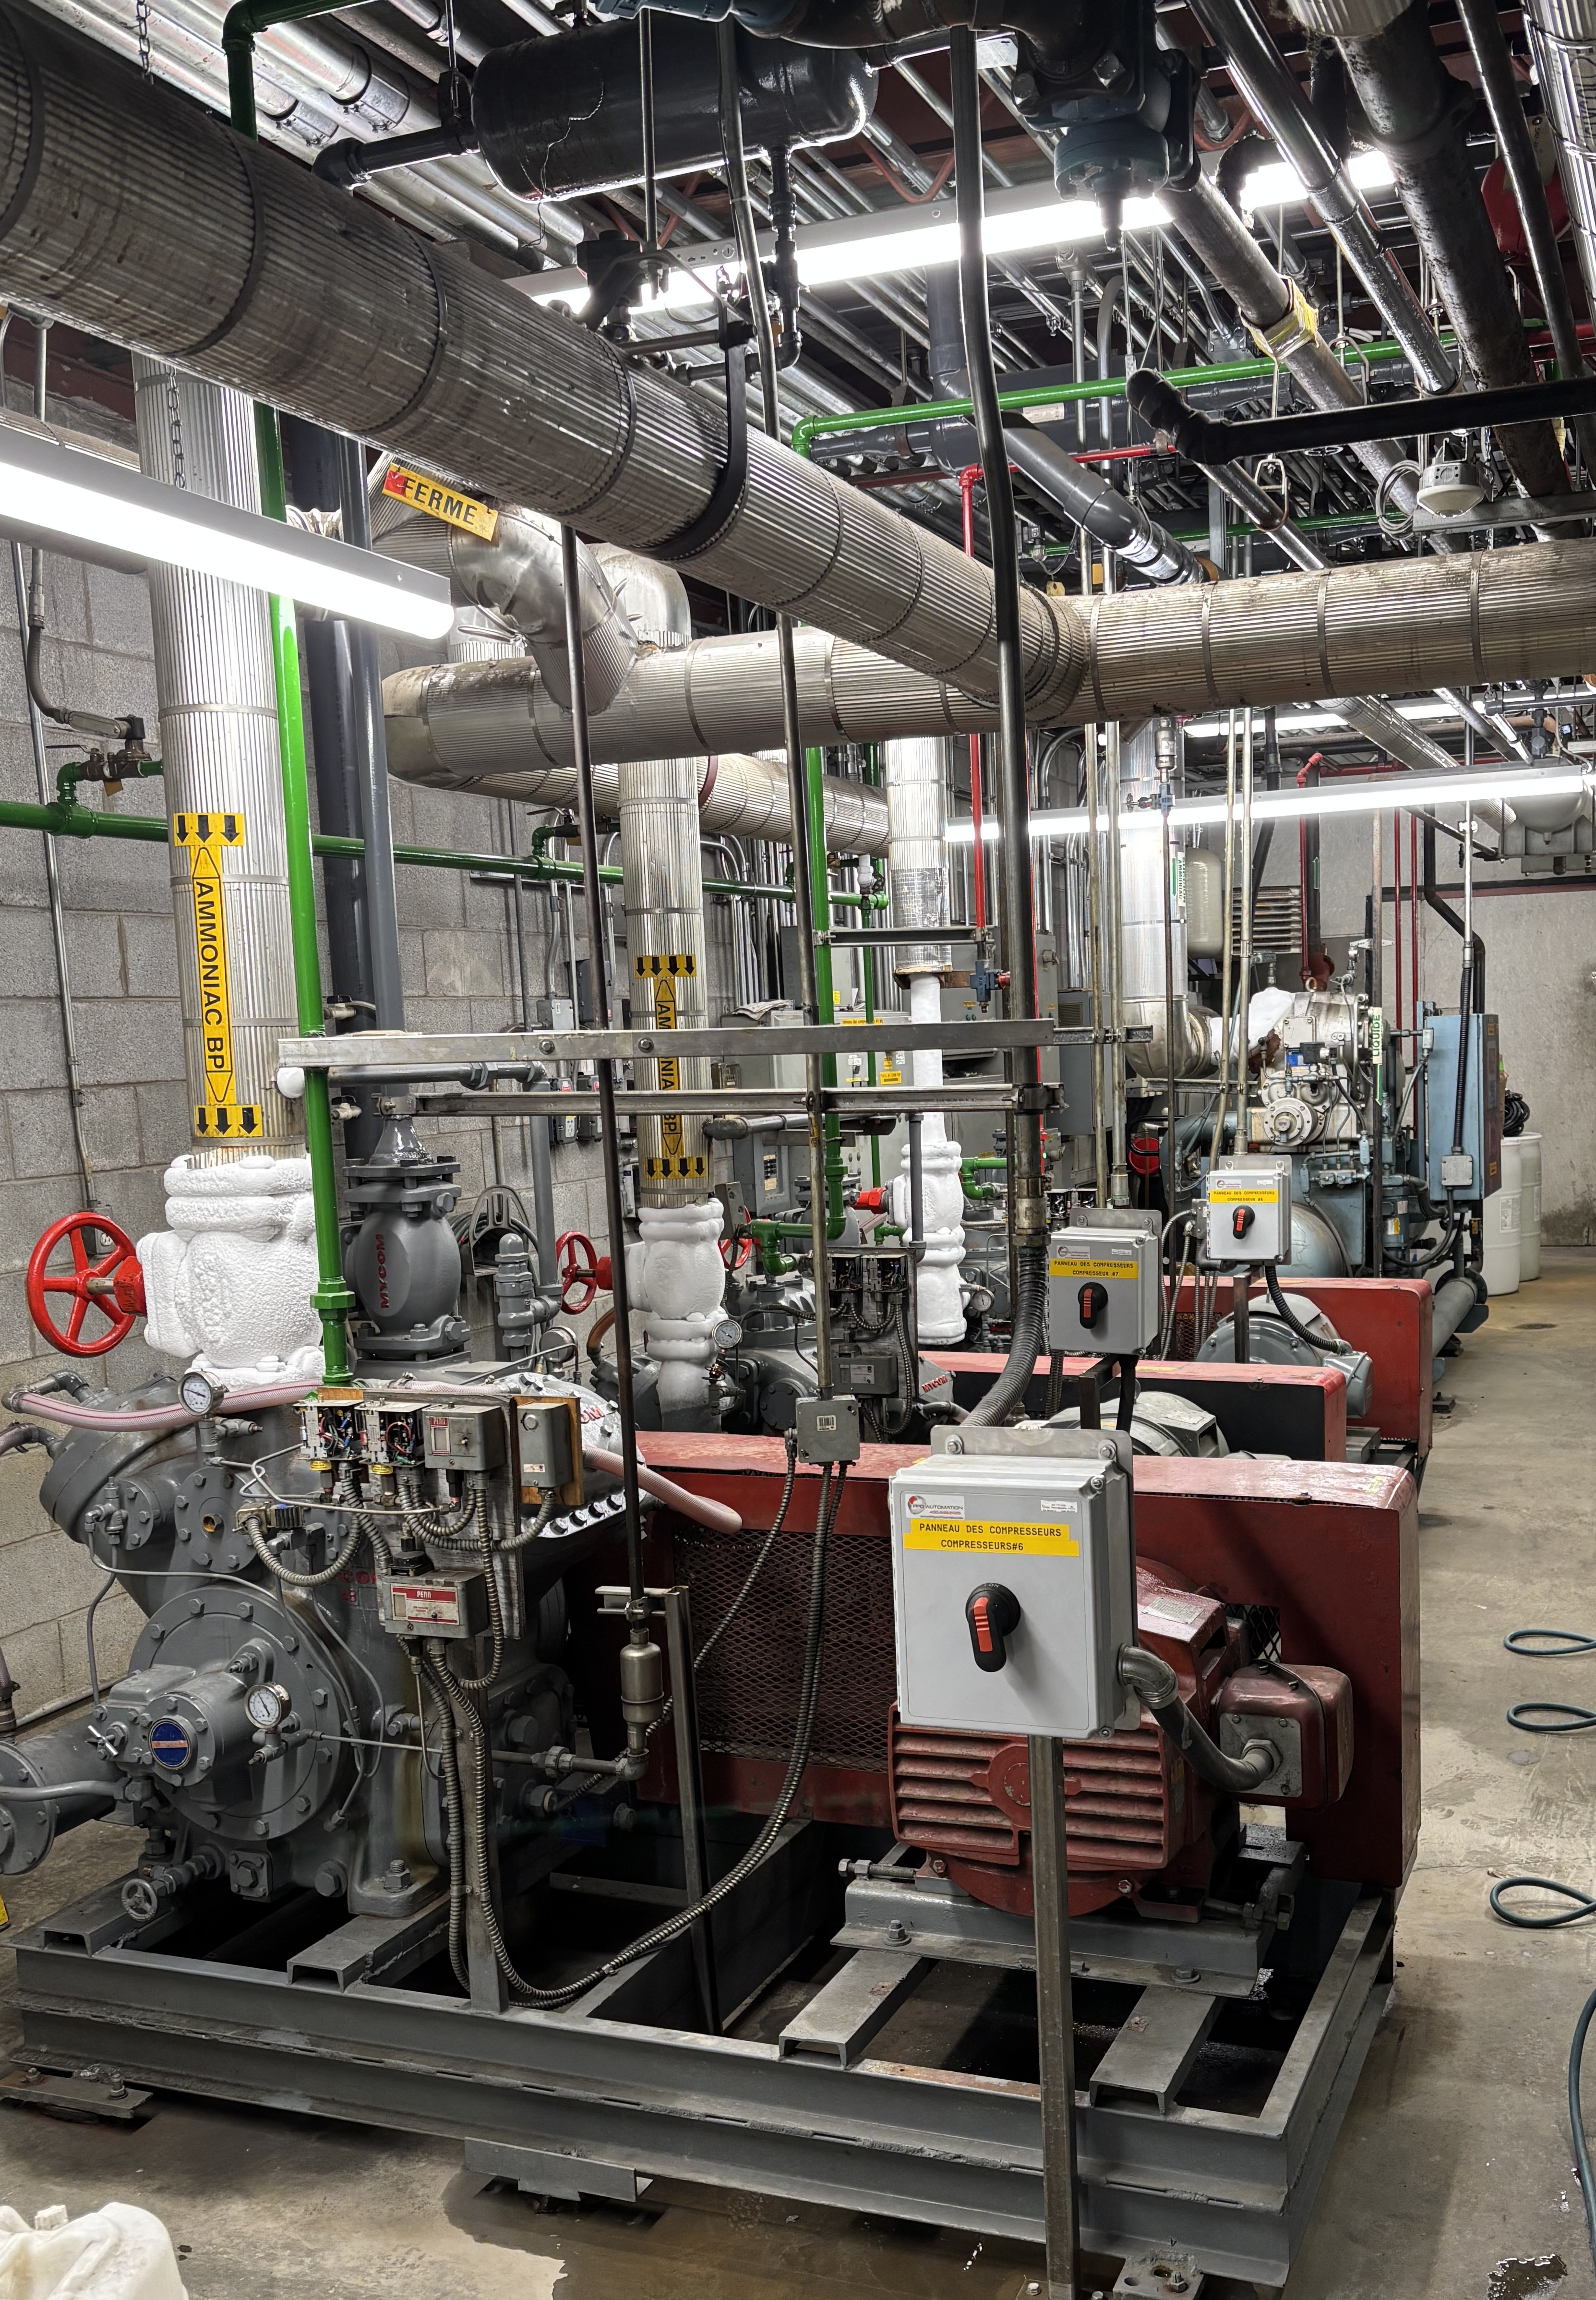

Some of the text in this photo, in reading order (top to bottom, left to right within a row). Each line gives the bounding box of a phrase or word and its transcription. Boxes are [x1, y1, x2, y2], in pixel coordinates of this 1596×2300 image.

[404, 476, 477, 526] FERME
[196, 881, 225, 1070] AMMONIAC BP
[375, 1234, 390, 1308] MYCOM
[922, 1374, 948, 1393] MYCOM
[920, 1523, 1061, 1537] PANNEAU DES COMPRESSEURS
[941, 1539, 1023, 1551] COMPRESSEURS#6
[417, 1590, 432, 1599] PENN
